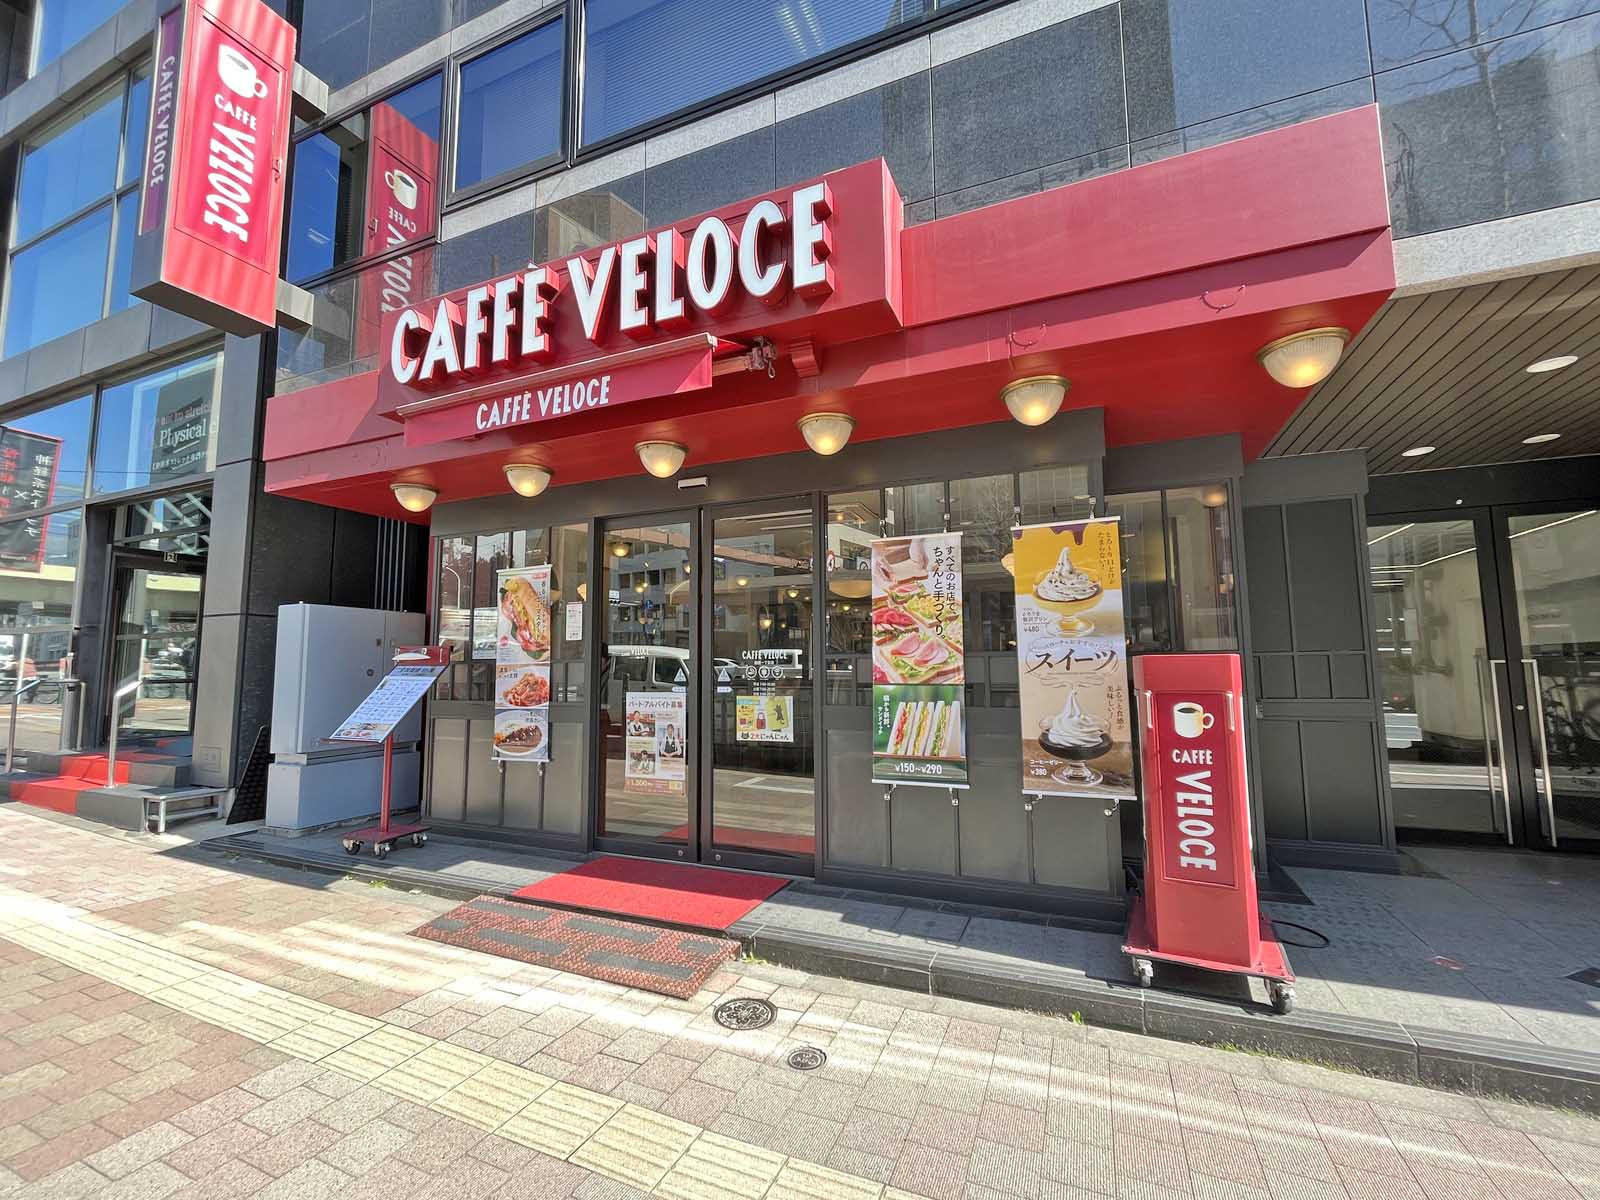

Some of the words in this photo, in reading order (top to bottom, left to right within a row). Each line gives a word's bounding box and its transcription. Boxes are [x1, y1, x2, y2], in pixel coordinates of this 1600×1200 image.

[151, 114, 170, 187] VELOCE
[204, 122, 256, 243] VELOCE
[567, 183, 828, 341] VELOCE
[537, 376, 611, 417] VELOCE
[160, 418, 206, 449] Physical
[933, 546, 947, 640] ちゃんと手づくり。
[945, 545, 956, 615] すべてのお店で、
[1026, 648, 1117, 674] スイーツ
[1175, 770, 1217, 871] VELOCE
